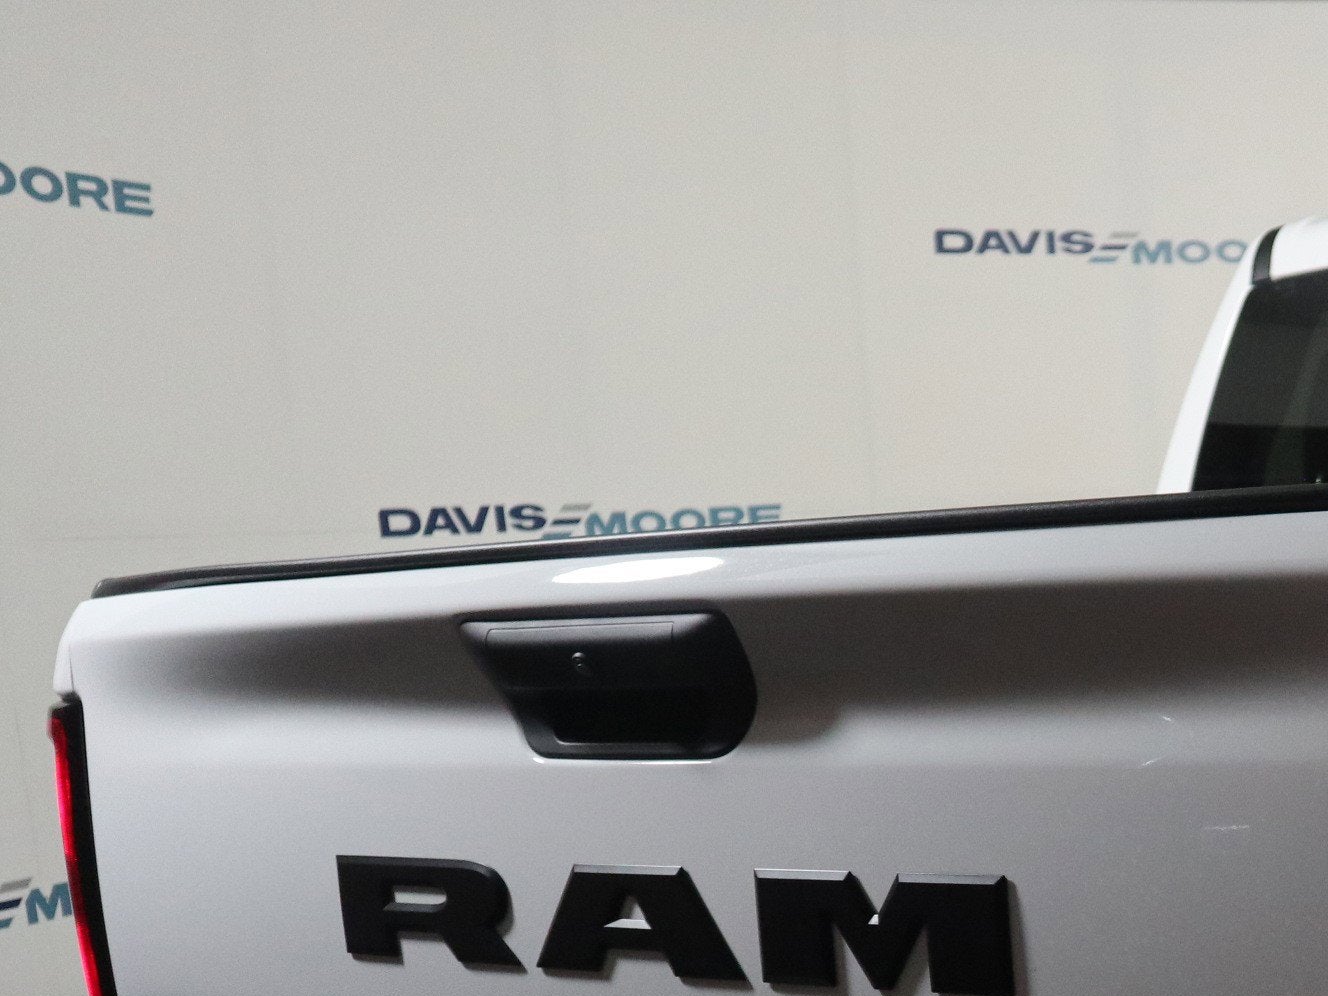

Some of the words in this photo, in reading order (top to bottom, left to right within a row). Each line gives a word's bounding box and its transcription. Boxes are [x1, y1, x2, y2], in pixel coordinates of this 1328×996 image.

[933, 228, 1096, 255] DAVIS
[378, 503, 548, 539] DAVIS
[584, 503, 783, 536] MOORE
